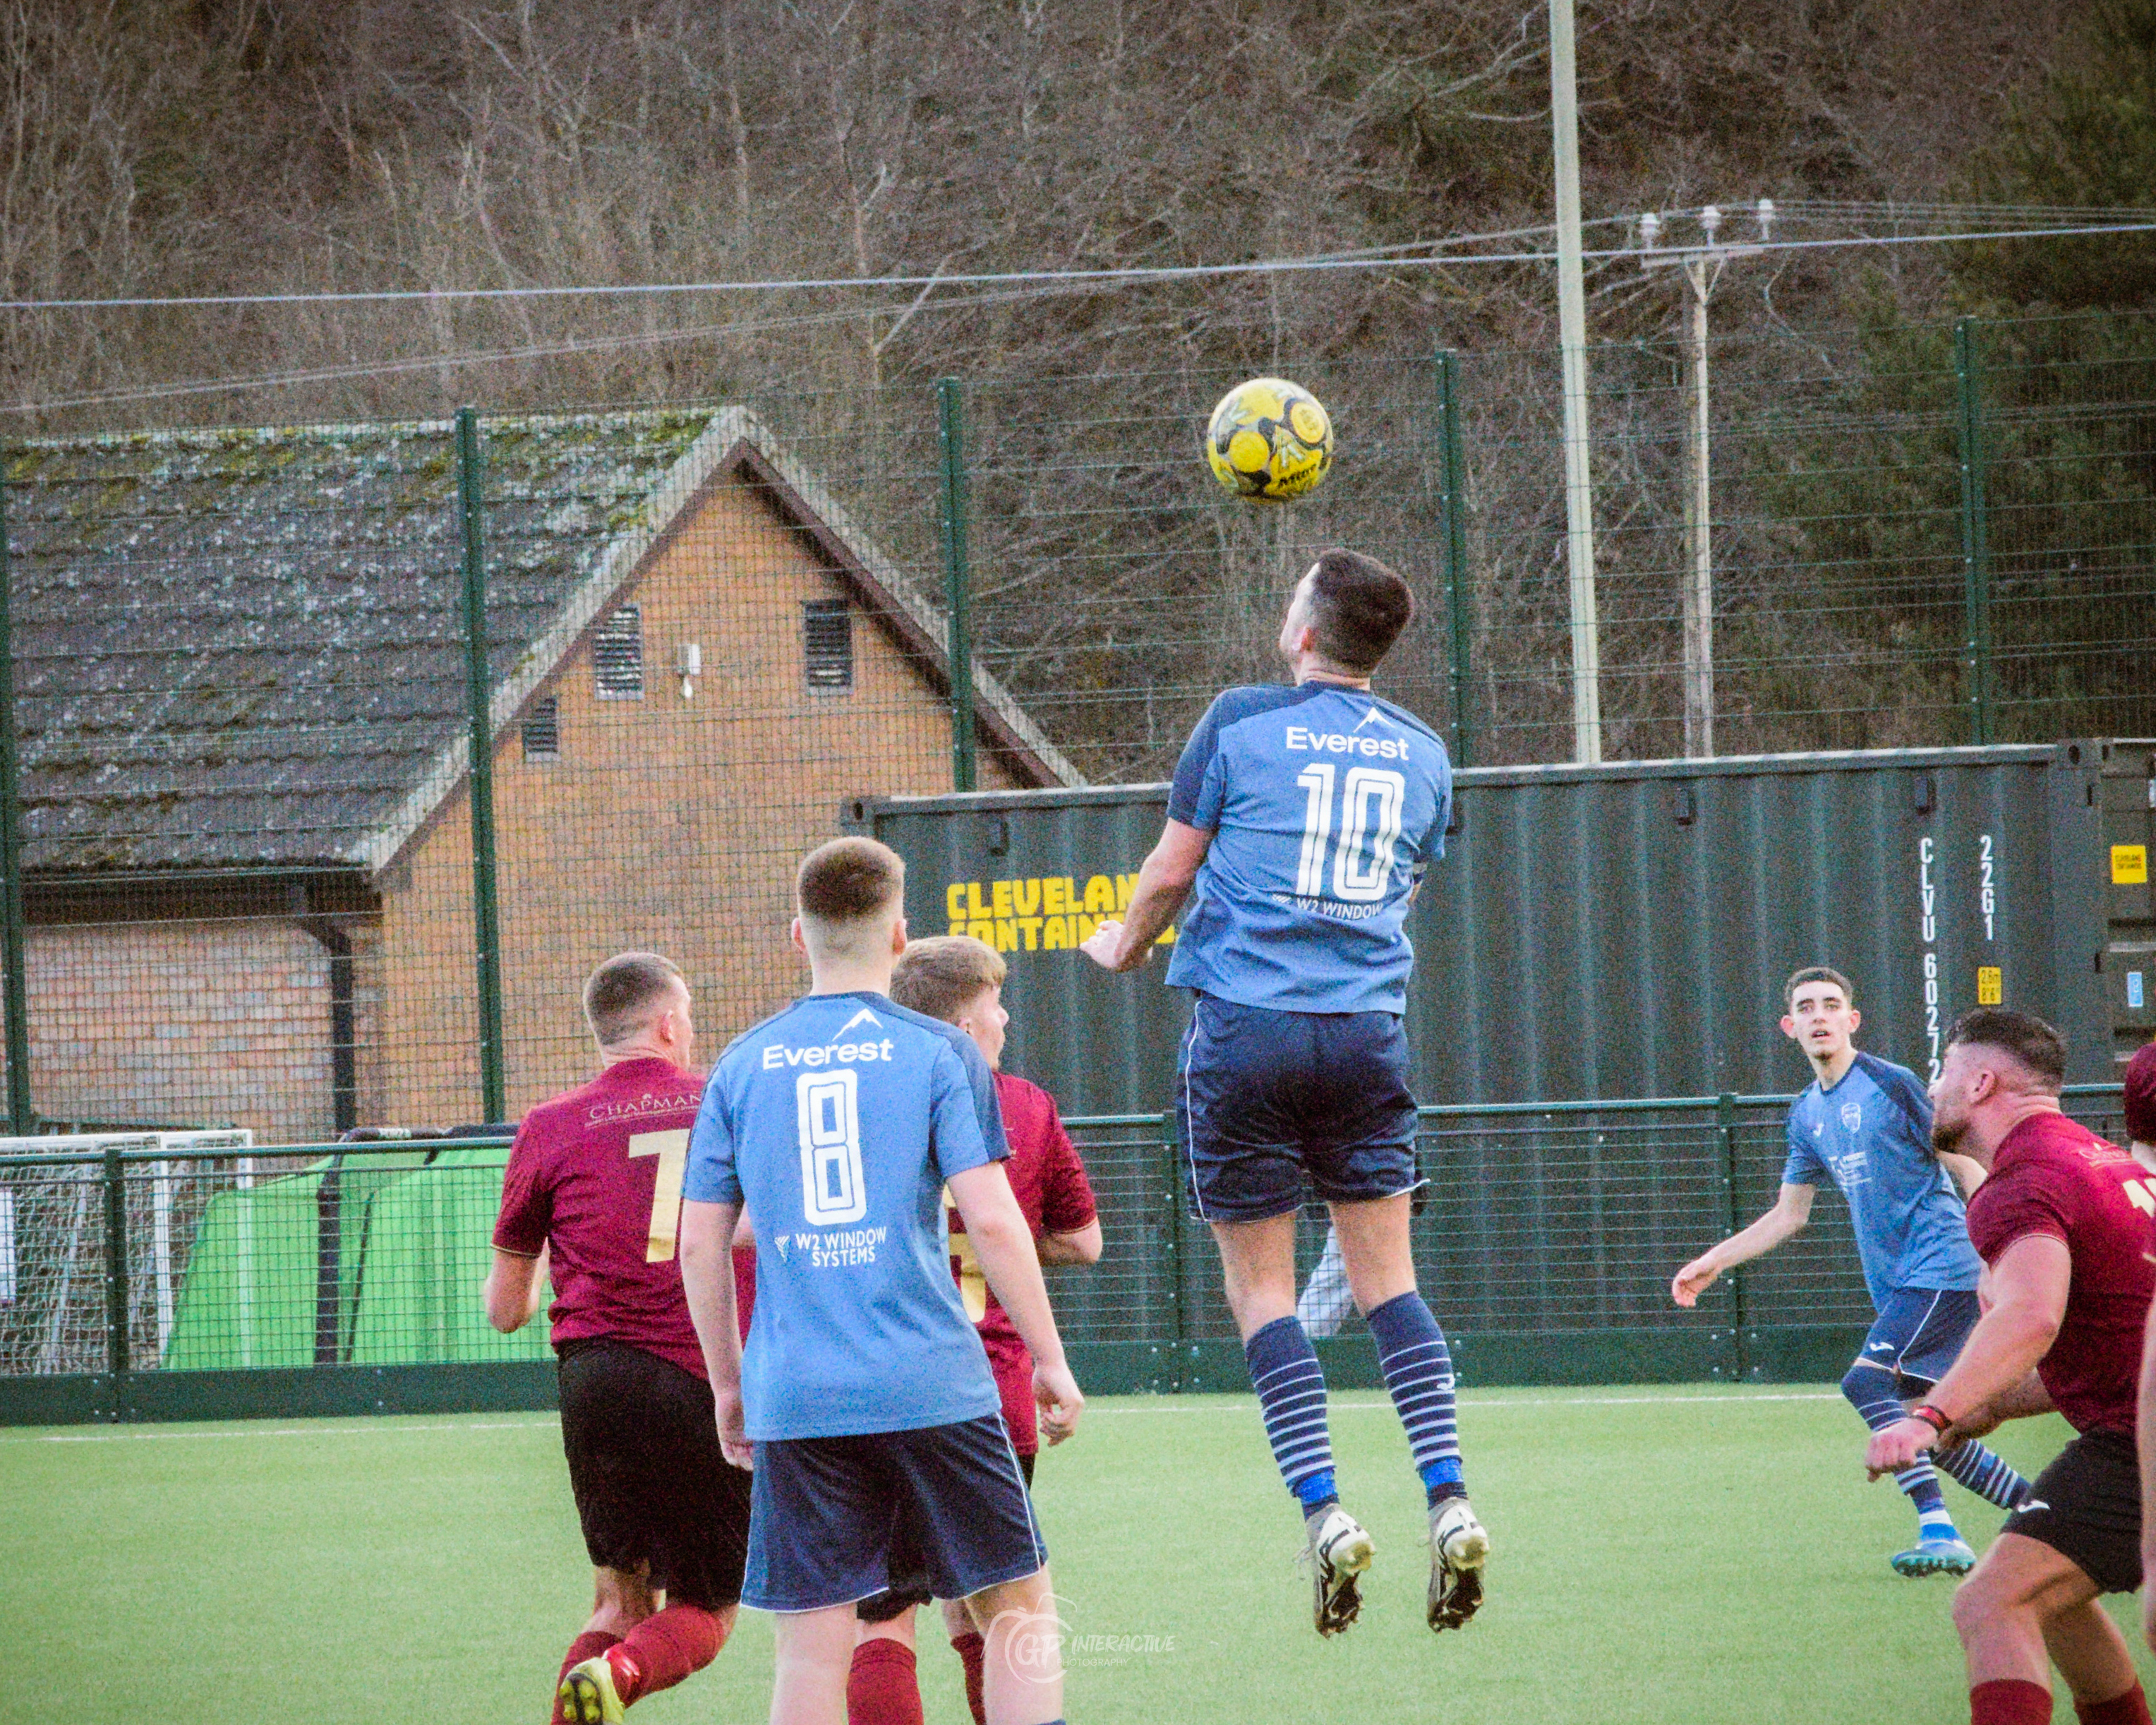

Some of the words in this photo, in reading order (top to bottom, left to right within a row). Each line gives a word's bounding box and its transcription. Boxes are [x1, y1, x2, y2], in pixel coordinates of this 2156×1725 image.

[1286, 726, 1409, 761] Everest
[1296, 762, 1405, 901] 10
[947, 873, 1139, 920] CLEVELAN
[1296, 897, 1318, 913] W2
[1323, 901, 1384, 920] WINDOW
[1920, 837, 1935, 942] CLVU
[1980, 835, 1995, 941] 22G1
[949, 912, 1176, 953] CONTAIN
[763, 1038, 894, 1071] Everest
[590, 1095, 701, 1119] CHAPMAN
[796, 1068, 867, 1227] 8
[628, 1129, 691, 1263] 7
[795, 1234, 819, 1251] W2
[824, 1226, 886, 1250] WINDOW
[812, 1246, 876, 1268] SYSTEMS
